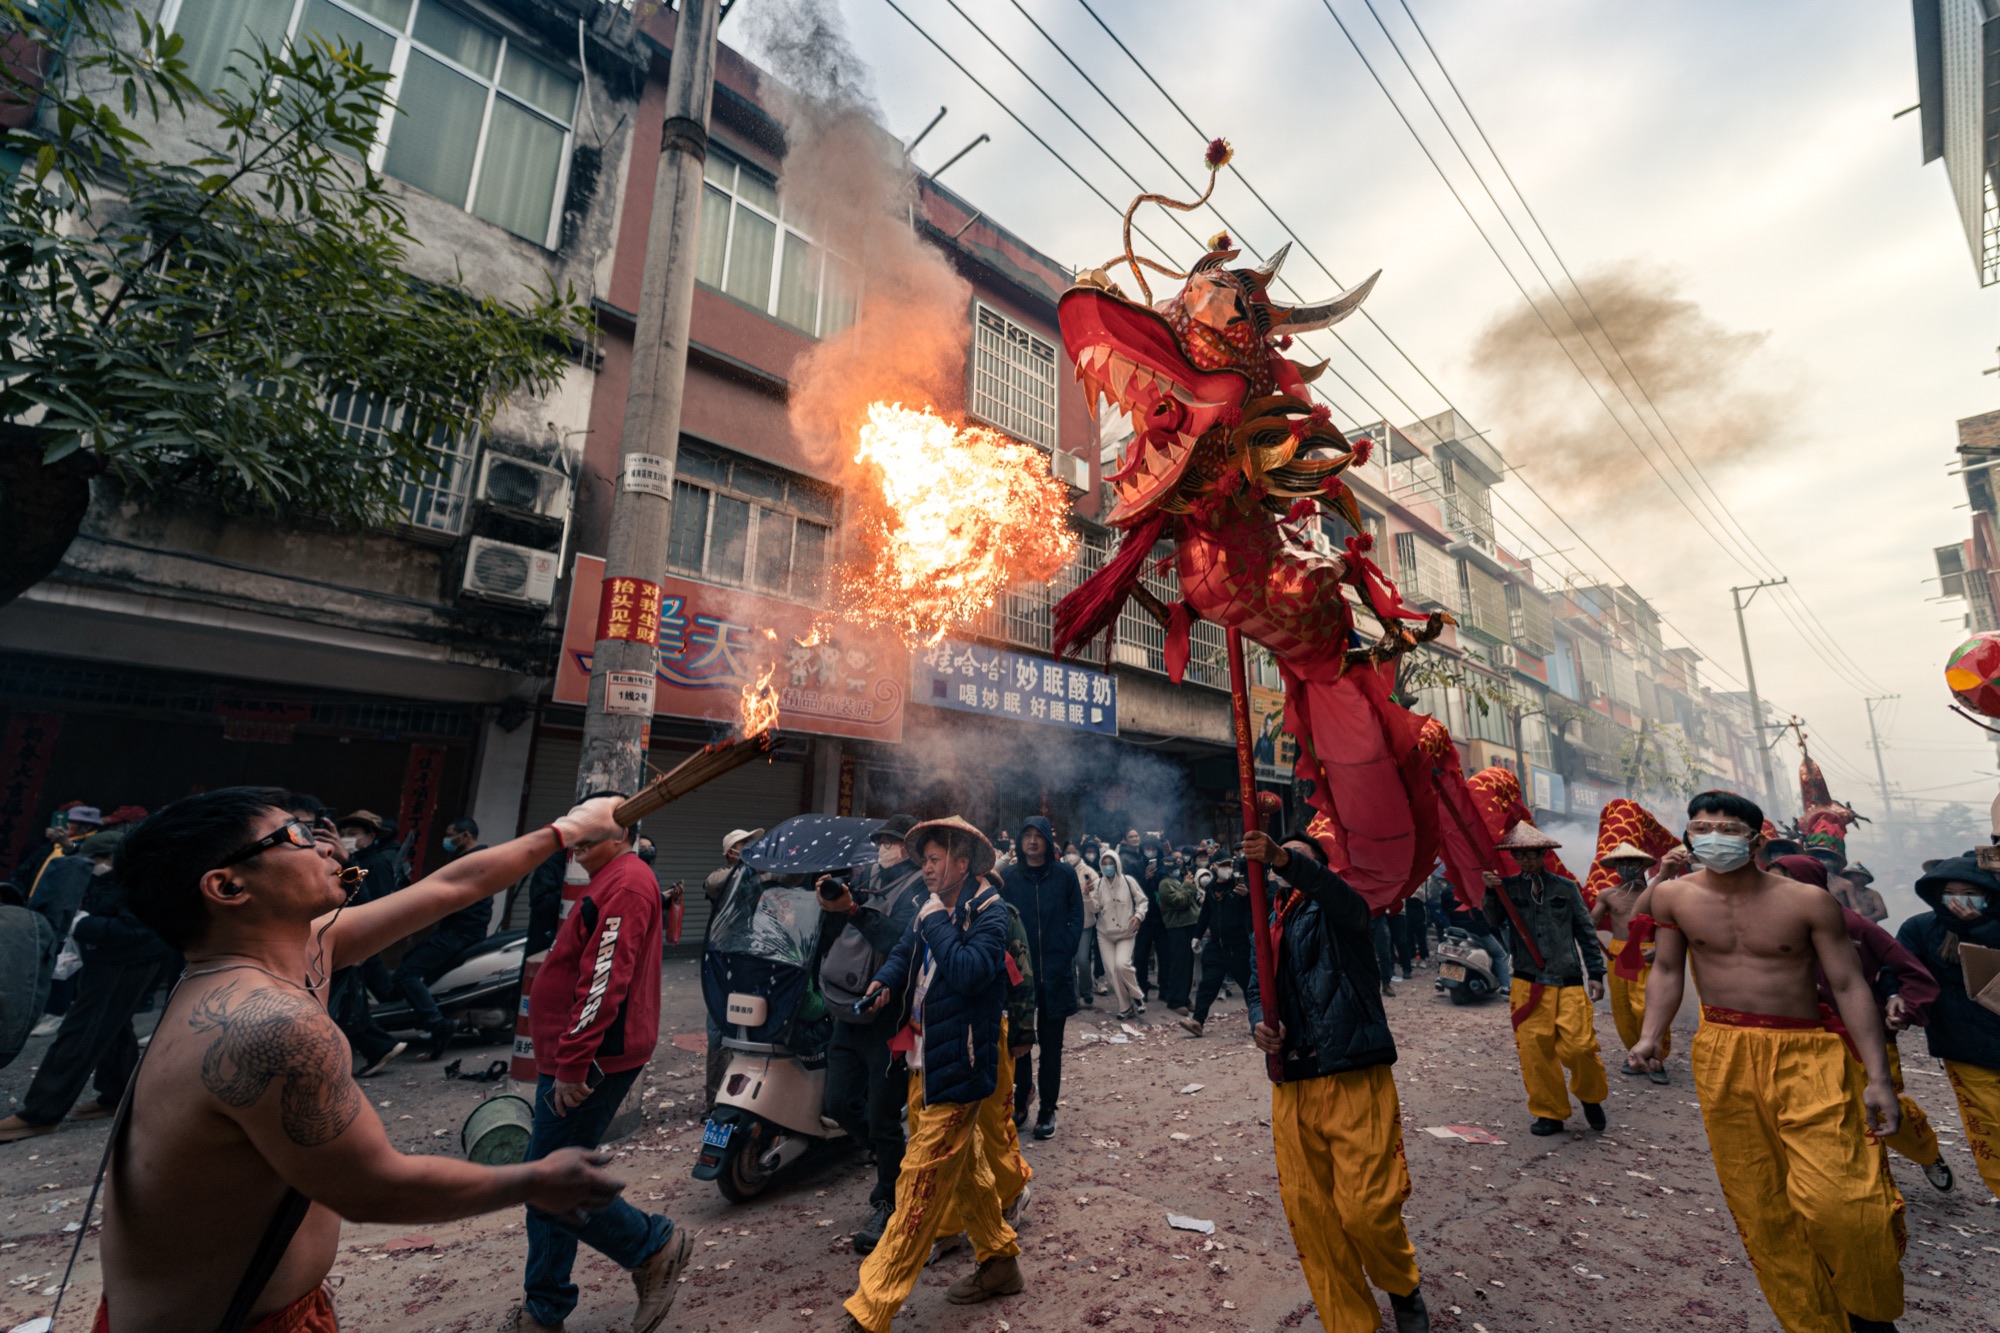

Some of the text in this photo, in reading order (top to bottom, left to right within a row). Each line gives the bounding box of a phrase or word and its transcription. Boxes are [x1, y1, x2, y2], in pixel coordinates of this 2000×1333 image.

[606, 577, 636, 638] 抬头见喜
[635, 583, 660, 644] 对我生财
[618, 690, 648, 703] 1线2号
[780, 687, 873, 718] 精品童装店
[923, 642, 1111, 707] 娃哈哈 妙眠酸奶
[958, 683, 1085, 726] 喝妙眠 好睡眠
[568, 916, 622, 1034] PARADISE
